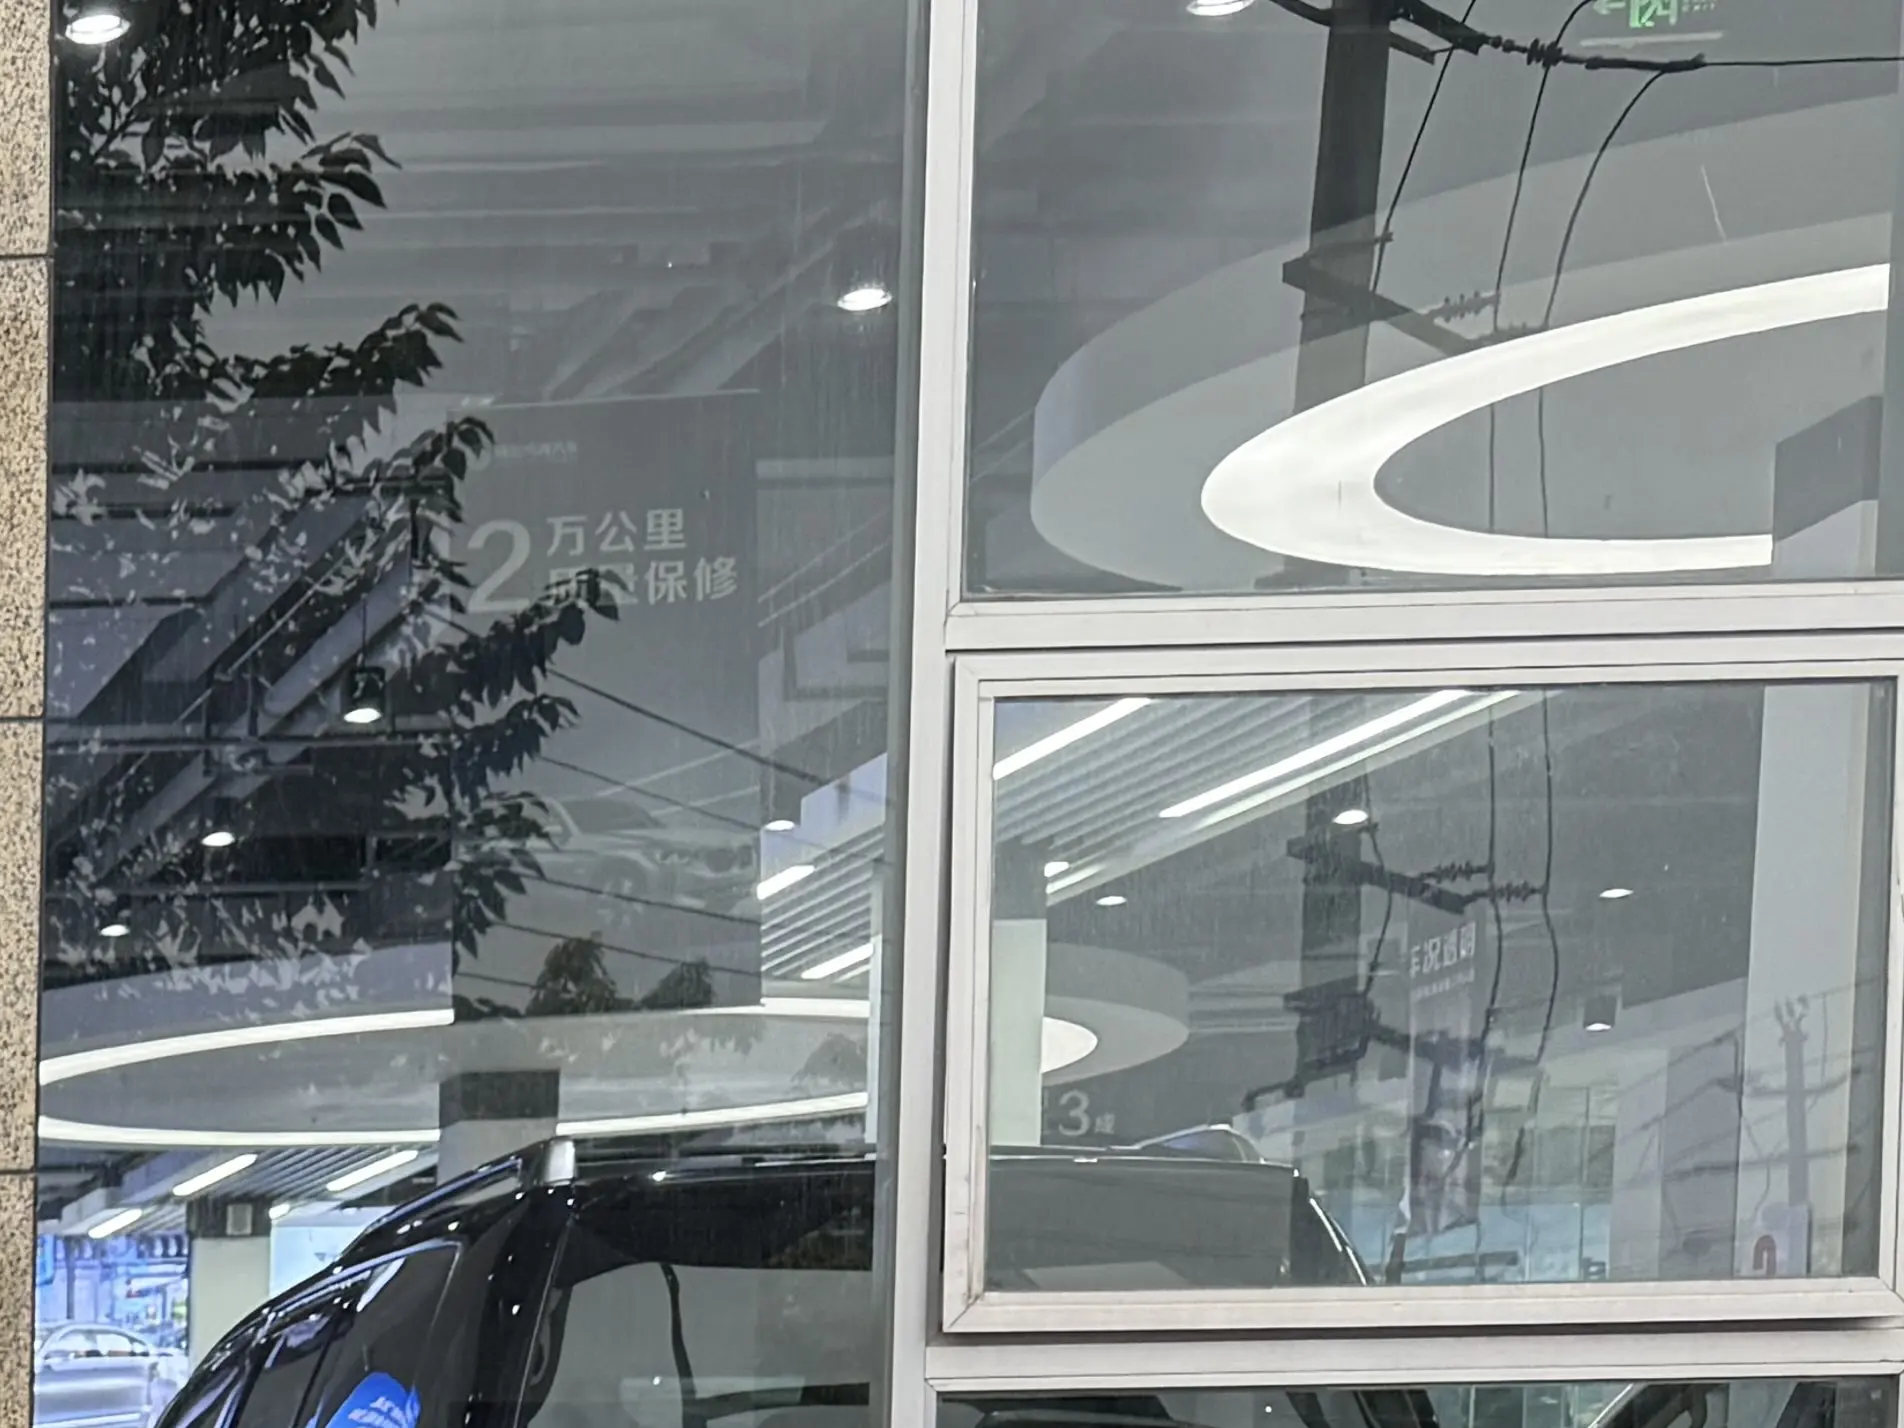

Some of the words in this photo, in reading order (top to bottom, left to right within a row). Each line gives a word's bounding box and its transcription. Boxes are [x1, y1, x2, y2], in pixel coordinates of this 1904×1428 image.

[466, 519, 531, 613] 2
[546, 508, 687, 557] 万公里
